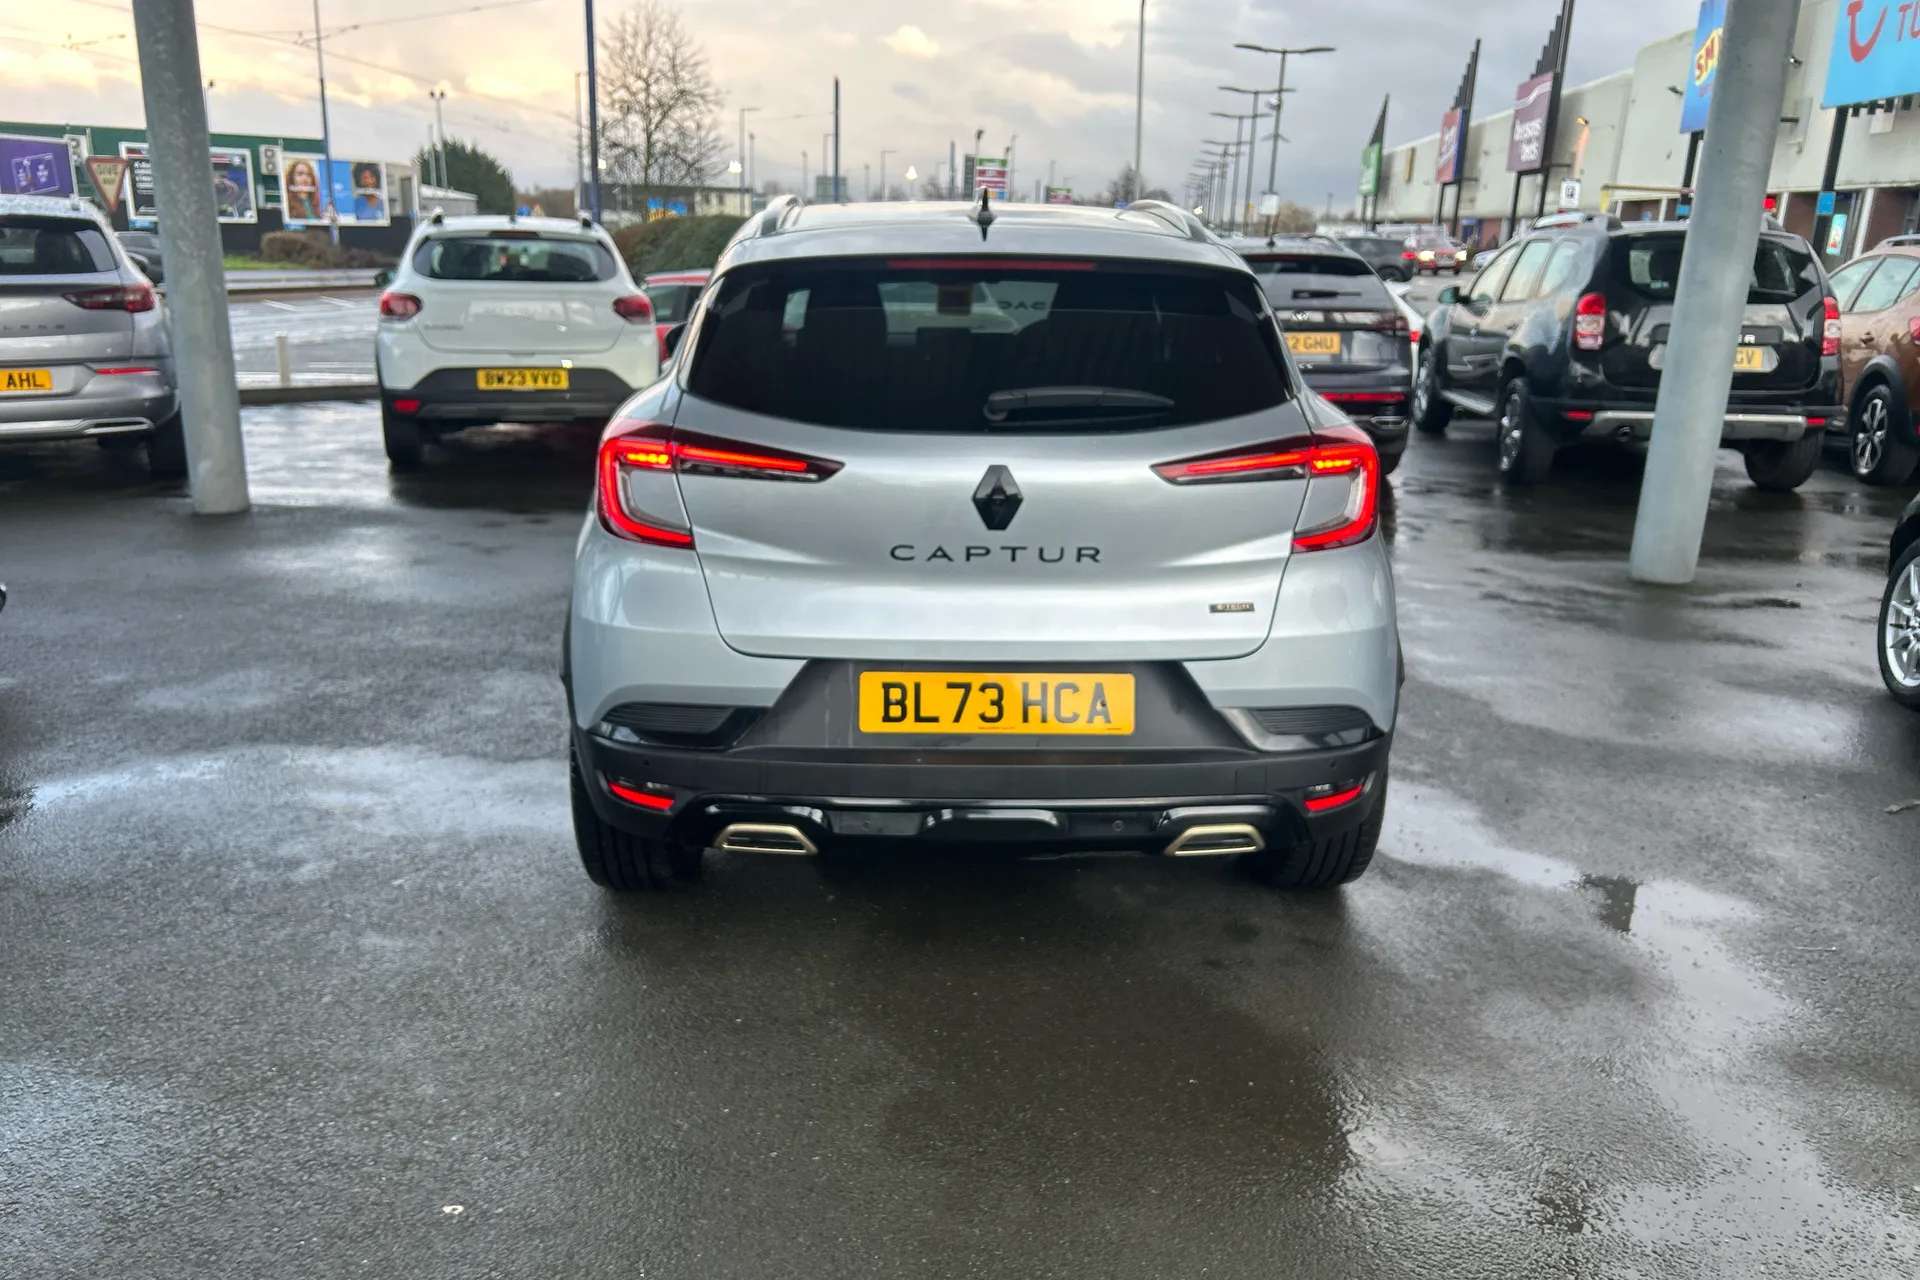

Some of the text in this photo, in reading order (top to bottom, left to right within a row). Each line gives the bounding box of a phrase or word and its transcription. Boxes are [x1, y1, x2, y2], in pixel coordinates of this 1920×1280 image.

[1303, 336, 1333, 350] GHU
[6, 372, 45, 388] AHL
[890, 544, 1101, 563] CAPTUR
[881, 681, 1112, 724] BL73 HCA
